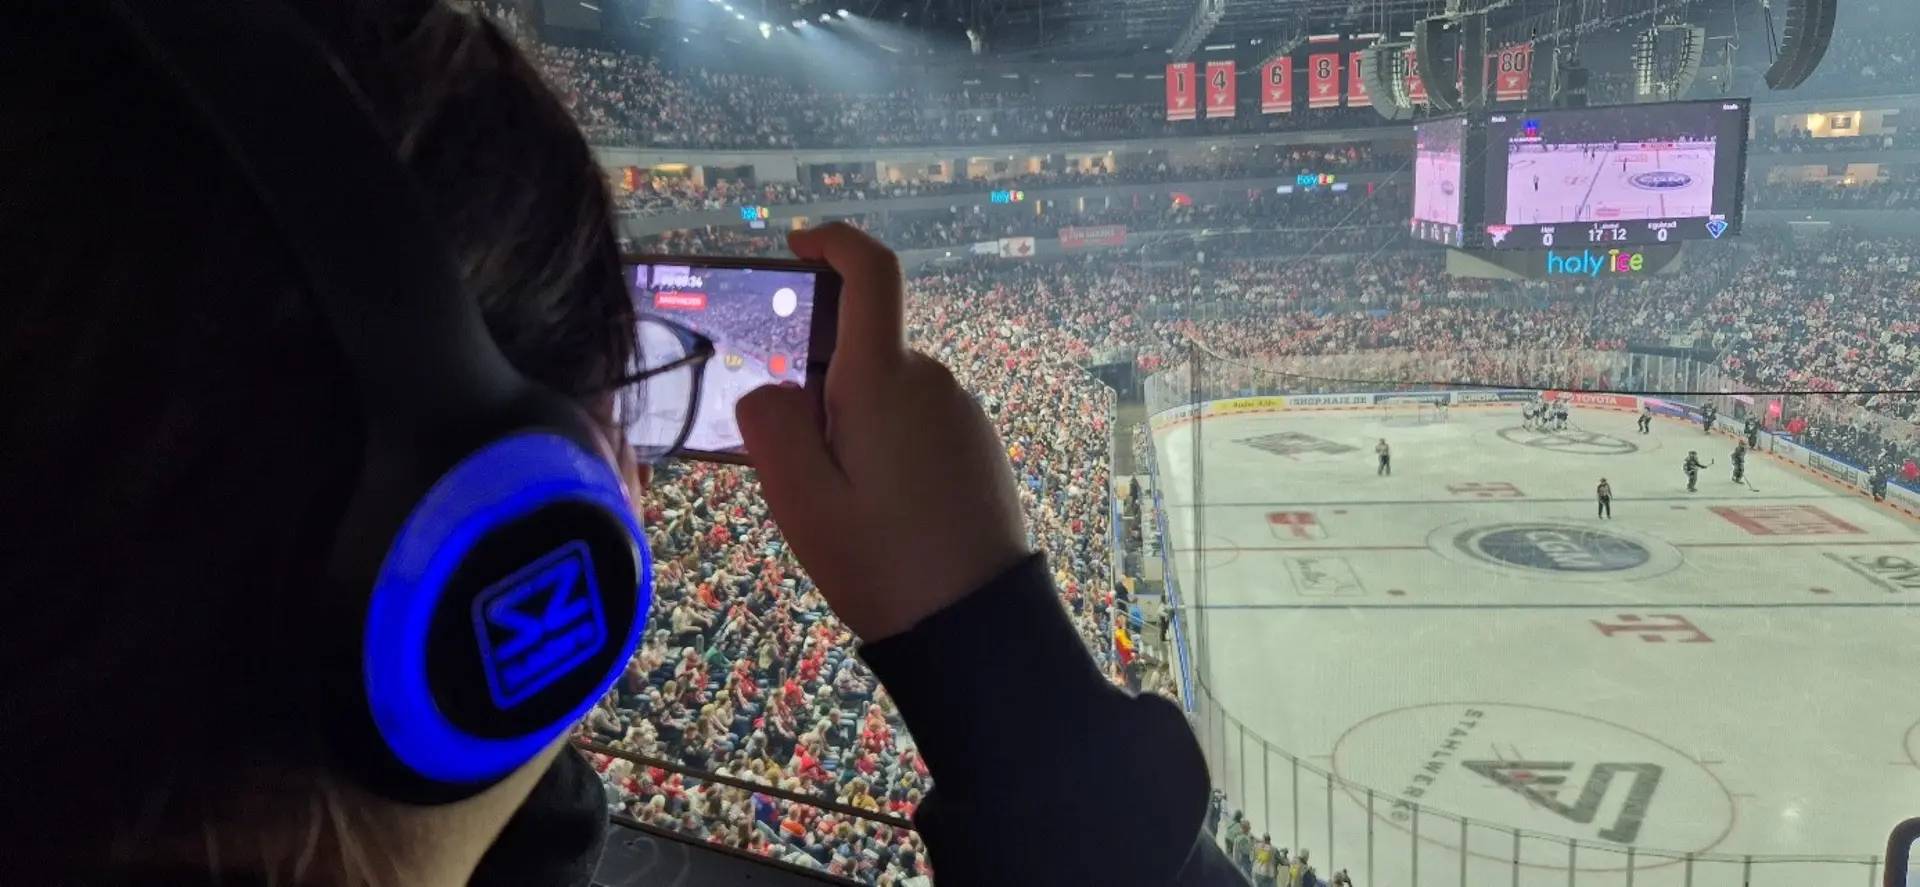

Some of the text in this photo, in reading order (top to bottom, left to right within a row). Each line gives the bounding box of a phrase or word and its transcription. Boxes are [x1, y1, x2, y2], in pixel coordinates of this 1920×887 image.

[1317, 58, 1331, 80] 8
[1500, 51, 1527, 73] 80
[1176, 72, 1185, 92] 1
[1212, 69, 1228, 90] 4
[1269, 65, 1283, 86] 6
[1543, 233, 1553, 246] 0
[1658, 229, 1667, 241] 0
[1547, 249, 1643, 278] holy ice
[1576, 394, 1617, 405] TOYOTA
